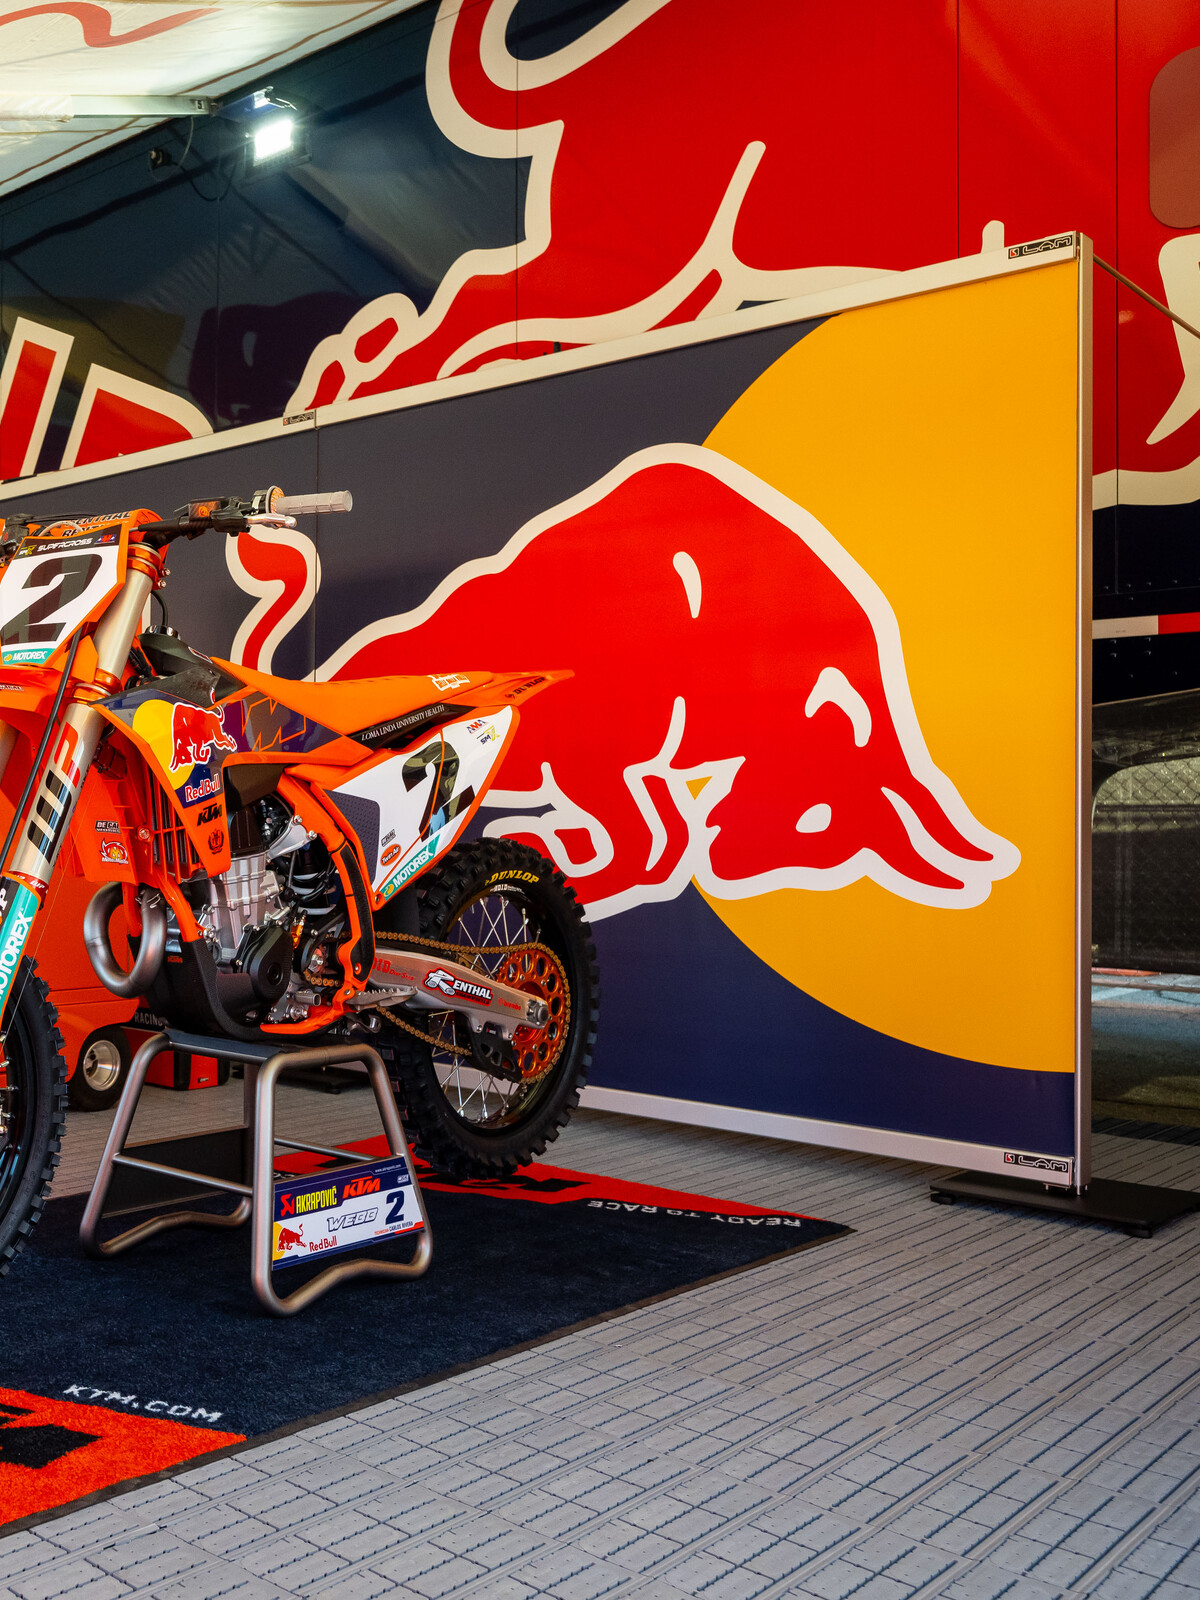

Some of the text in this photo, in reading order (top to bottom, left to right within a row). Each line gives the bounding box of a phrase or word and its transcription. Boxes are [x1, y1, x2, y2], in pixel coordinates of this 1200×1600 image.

[1022, 236, 1071, 255] LAM
[37, 538, 93, 552] SUPERCROSS
[0, 553, 103, 647] 2
[12, 651, 48, 661] MOTOREX
[513, 675, 546, 695] DUNLOP
[361, 704, 445, 741] LOMA LINDA UNIVERSITY HEALTH
[468, 719, 487, 734] AMA
[185, 773, 220, 802] Red Bull
[402, 741, 475, 842] 2
[197, 803, 222, 826] KTM
[392, 846, 434, 888] MOTOREX
[489, 870, 540, 883] DUNLOP
[503, 1000, 522, 1010] brembo
[1018, 1155, 1068, 1172] LAM
[342, 1175, 381, 1199] KTM
[326, 1190, 405, 1233] WEBB 2
[587, 1200, 802, 1228] READY TO RACE
[389, 1223, 402, 1232] CARLOS
[309, 1235, 338, 1252] Red Bull
[62, 1382, 225, 1423] KTM.COM
